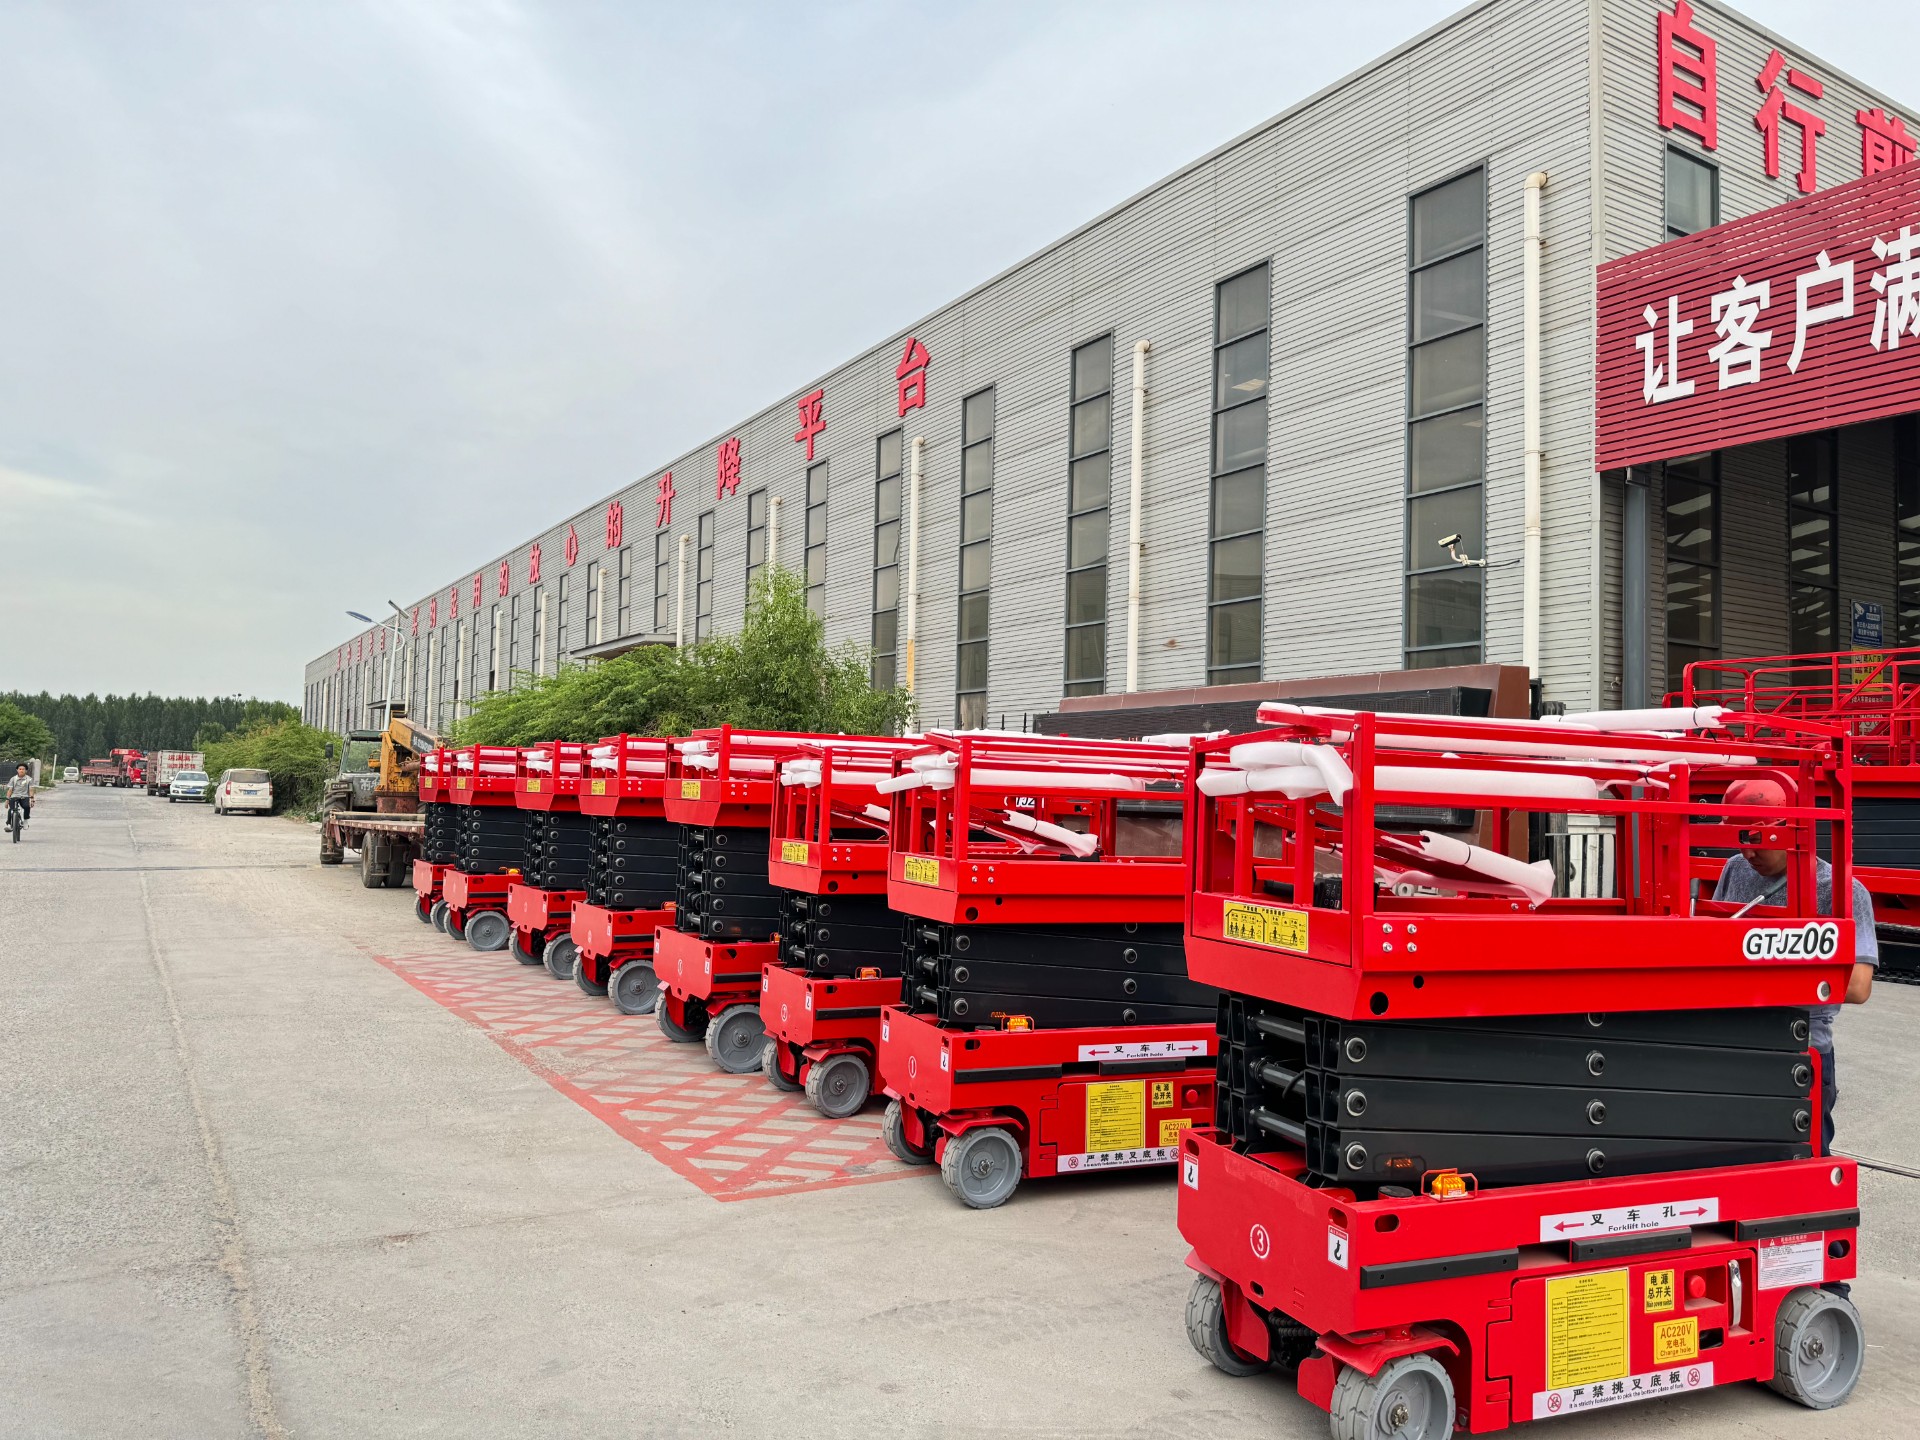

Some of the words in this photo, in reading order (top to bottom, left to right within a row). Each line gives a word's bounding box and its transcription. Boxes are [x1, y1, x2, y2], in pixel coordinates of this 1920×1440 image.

[1746, 927, 1835, 955] GTJZ06
[1114, 1043, 1176, 1054] 叉车孔
[1086, 1148, 1166, 1164] 严禁挑叉底板
[1590, 1205, 1677, 1226] 叉车孔
[1608, 1223, 1639, 1232] Forklift
[1640, 1221, 1660, 1229] hole
[1650, 1273, 1669, 1286] 电源
[1647, 1286, 1671, 1299] 总开关
[1660, 1323, 1692, 1339] AC220V
[1666, 1337, 1687, 1349] 充电孔
[1660, 1348, 1679, 1357] Charge
[1573, 1371, 1680, 1402] 严禁挑叉底板
[1641, 1388, 1657, 1396] bottom
